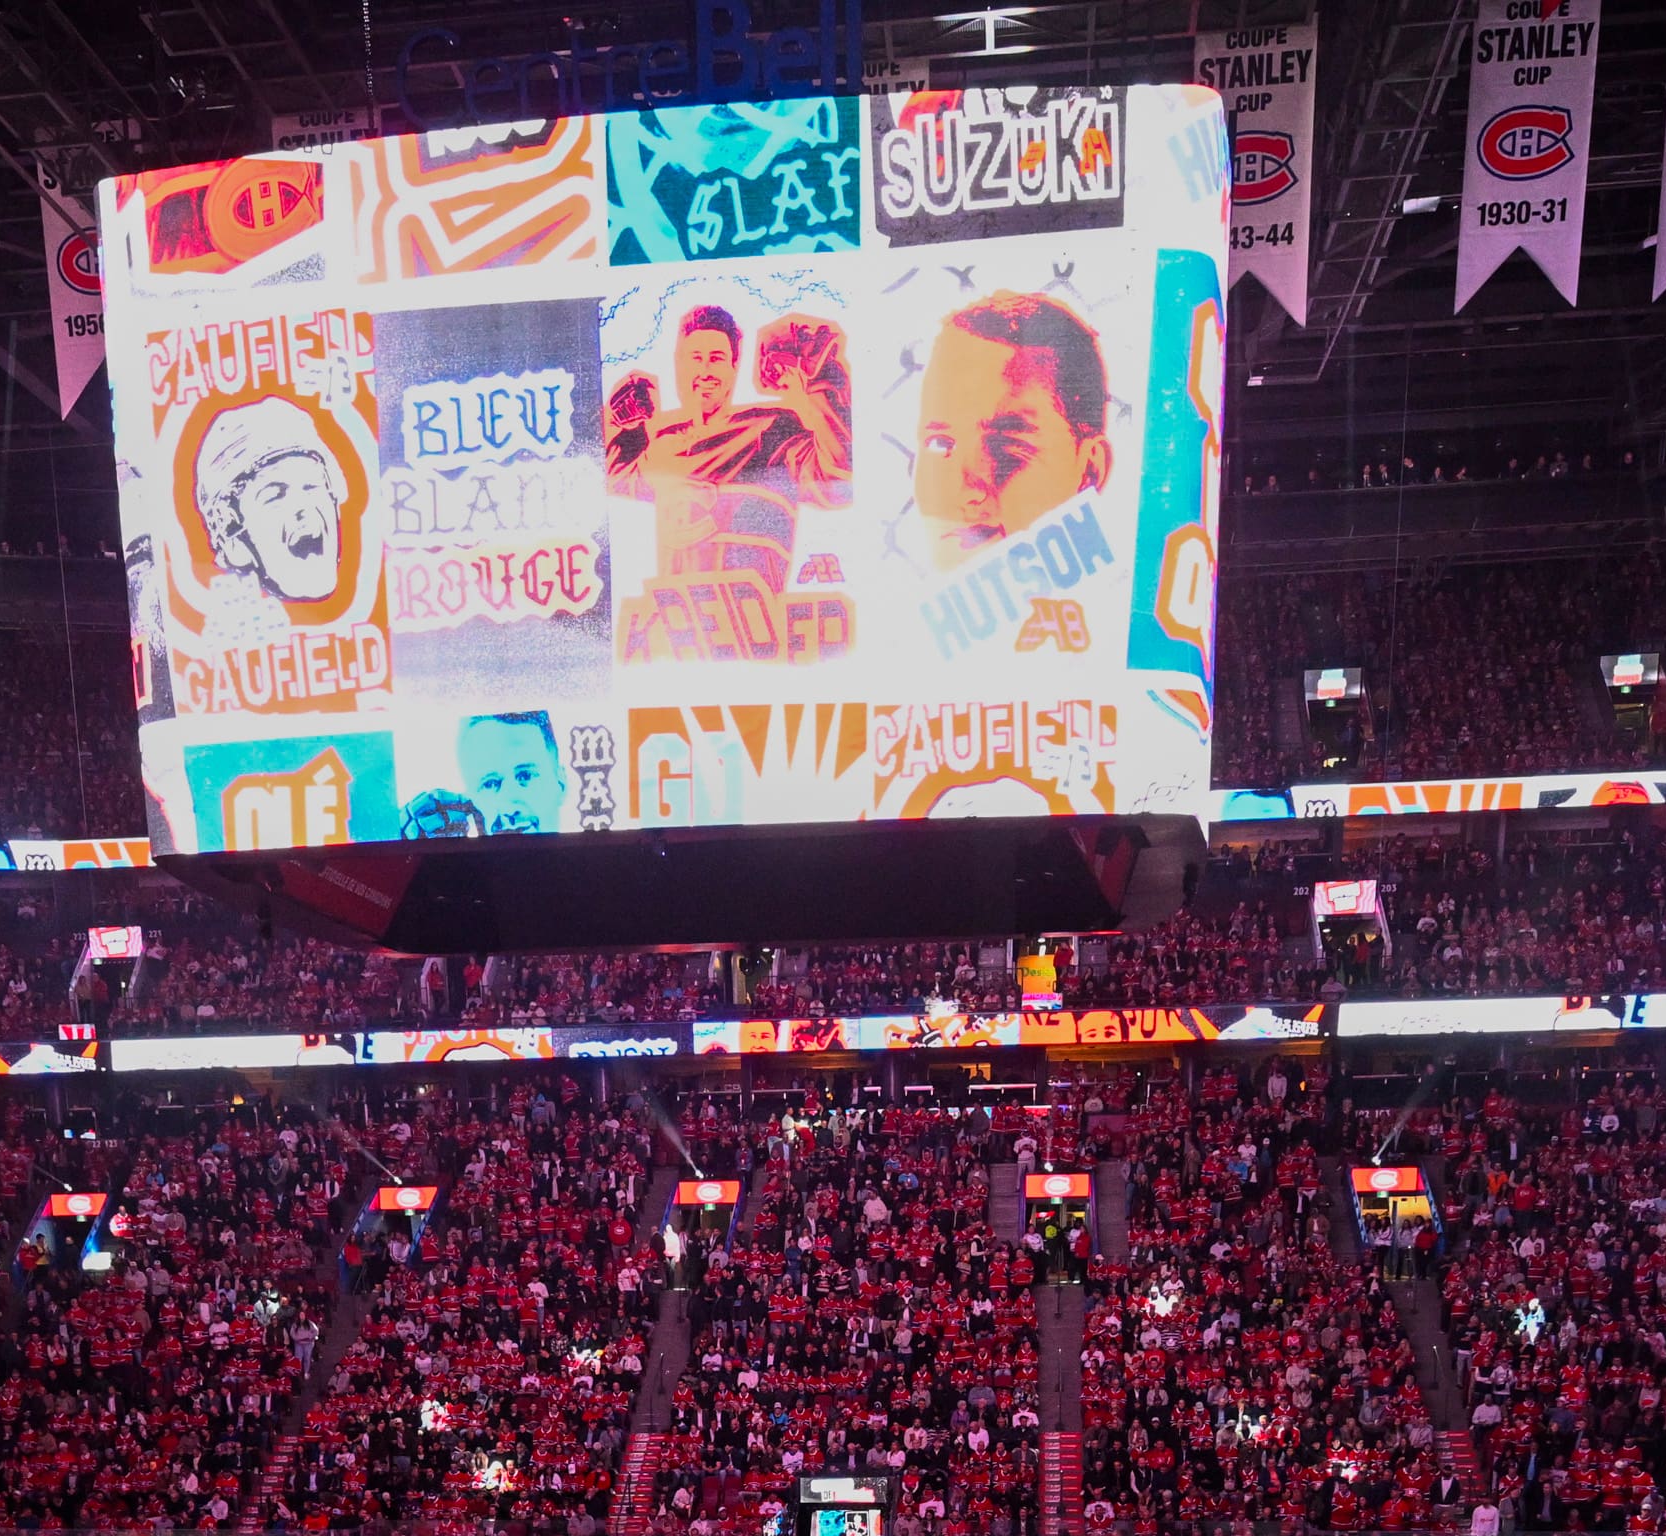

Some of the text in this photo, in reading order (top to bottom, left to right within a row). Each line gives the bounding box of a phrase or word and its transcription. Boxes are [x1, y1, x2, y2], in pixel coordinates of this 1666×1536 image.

[1507, 2, 1569, 20] COUE
[1226, 28, 1287, 49] COUPE
[1478, 23, 1593, 63] STANLEY
[1200, 49, 1313, 88] STANLEY
[1514, 67, 1551, 86] CUP
[1235, 93, 1273, 113] CUP
[882, 98, 1119, 218] SUZUKI
[1477, 199, 1567, 226] 1930-31
[1229, 222, 1295, 250] 43-44
[413, 384, 562, 459] BLEU
[393, 543, 592, 620] ROUGE
[920, 501, 1115, 662] HUTSON
[183, 623, 387, 714] CAUFIELD
[1293, 886, 1310, 896] 202
